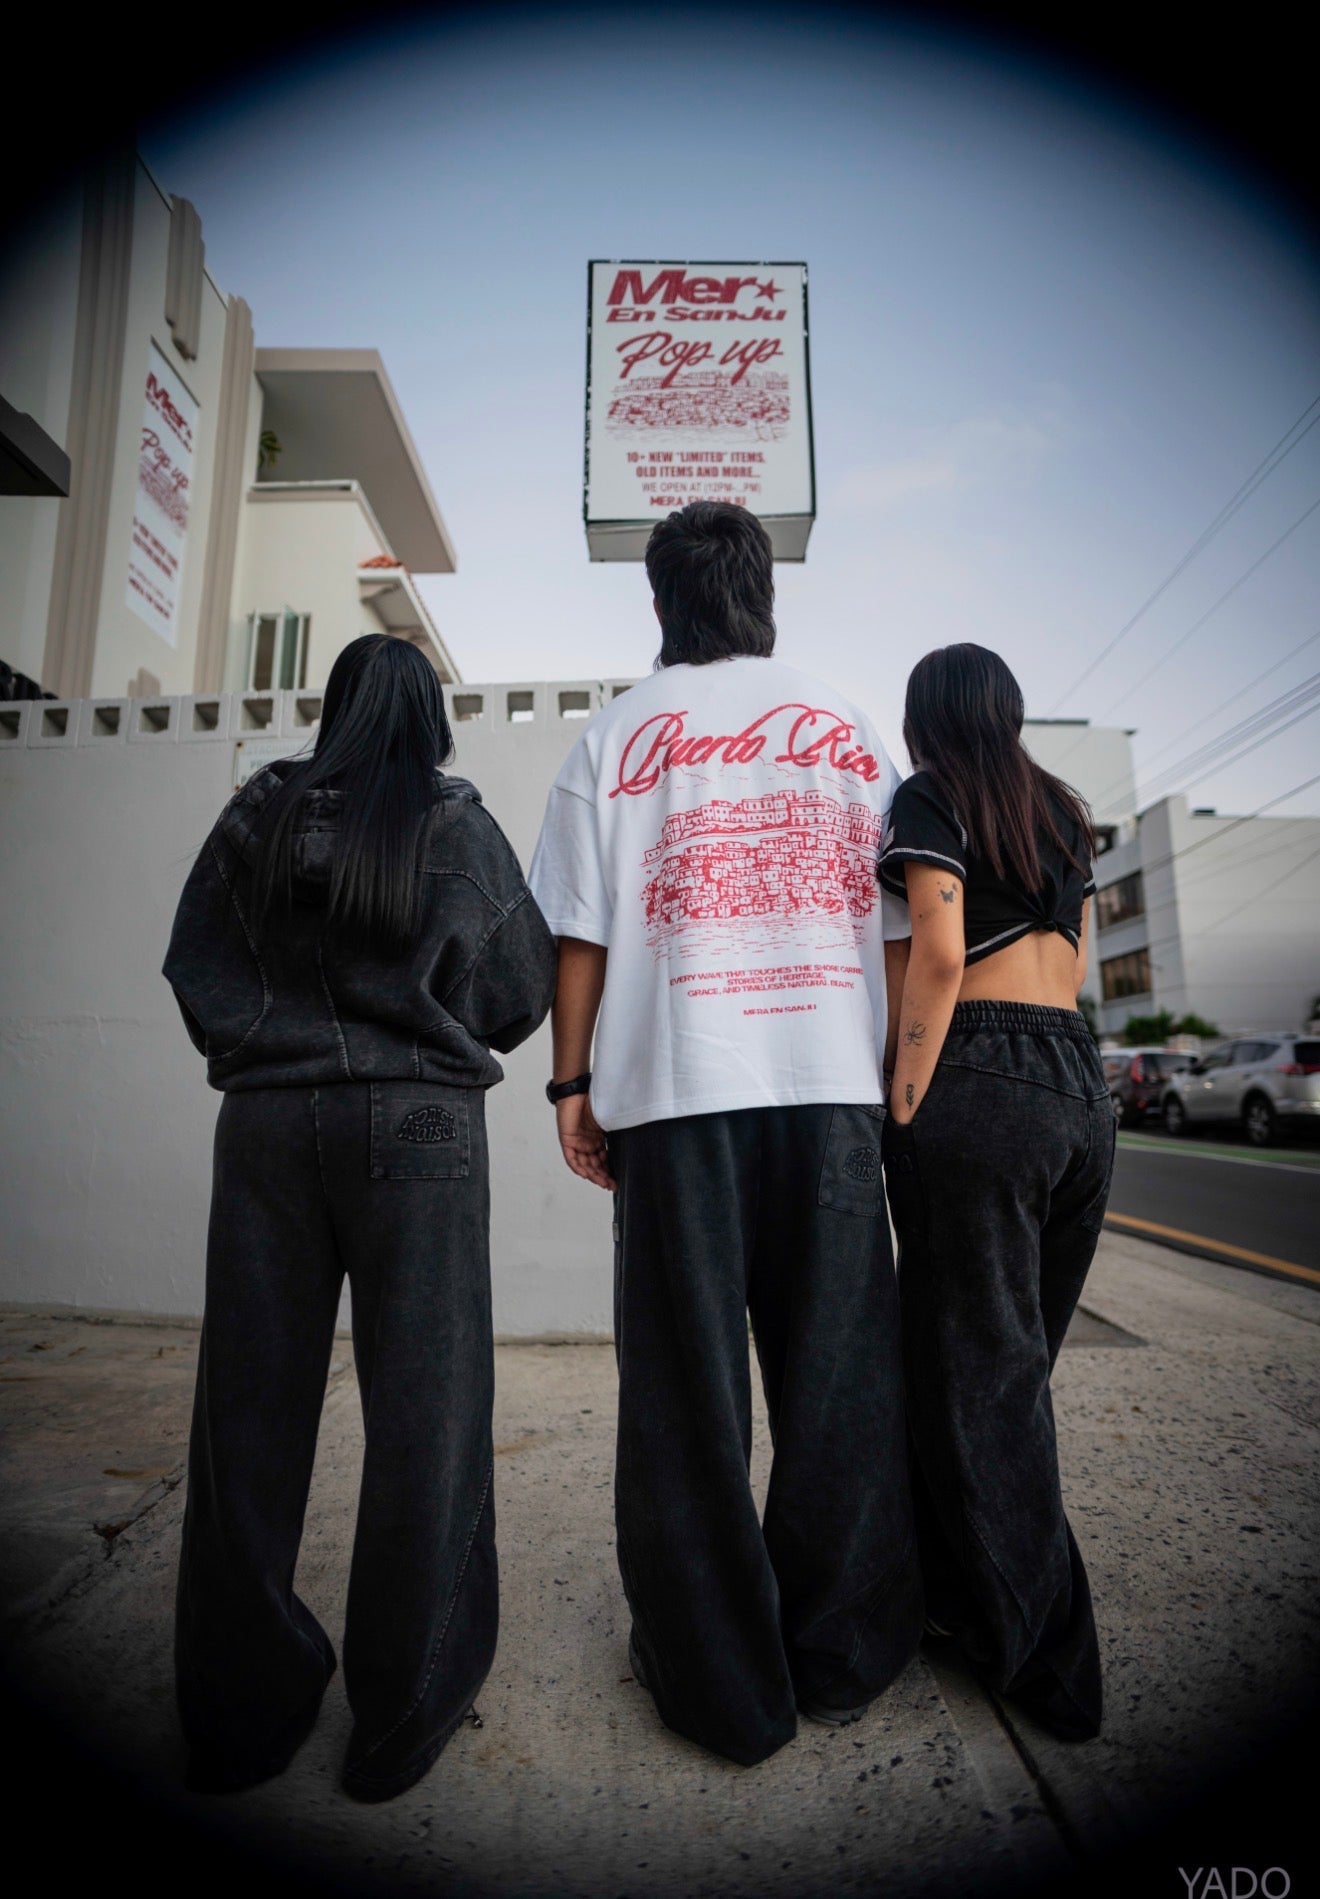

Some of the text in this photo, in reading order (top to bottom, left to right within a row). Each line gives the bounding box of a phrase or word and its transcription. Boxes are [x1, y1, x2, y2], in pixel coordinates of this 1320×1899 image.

[605, 306, 787, 323] En SanJu
[616, 331, 784, 390] Pop up
[141, 427, 171, 473] Pop
[649, 452, 673, 463] NEW
[636, 466, 657, 478] OLD
[660, 466, 694, 478] ITEMS
[697, 466, 719, 478] AND
[642, 482, 657, 493] WE
[659, 482, 688, 493] OPEN
[690, 482, 702, 493] AT
[649, 496, 684, 506] MERA
[608, 703, 816, 799] Puerto
[669, 974, 697, 987] EVERY
[698, 971, 723, 980] WAVE
[725, 970, 746, 978] THAT
[749, 966, 792, 976] TOUCHES
[794, 965, 812, 973] THE
[814, 964, 839, 973] SHORE
[727, 976, 764, 986] STORIES
[765, 975, 777, 983] OF
[723, 986, 741, 994] AND
[743, 982, 786, 992] TIMELESS
